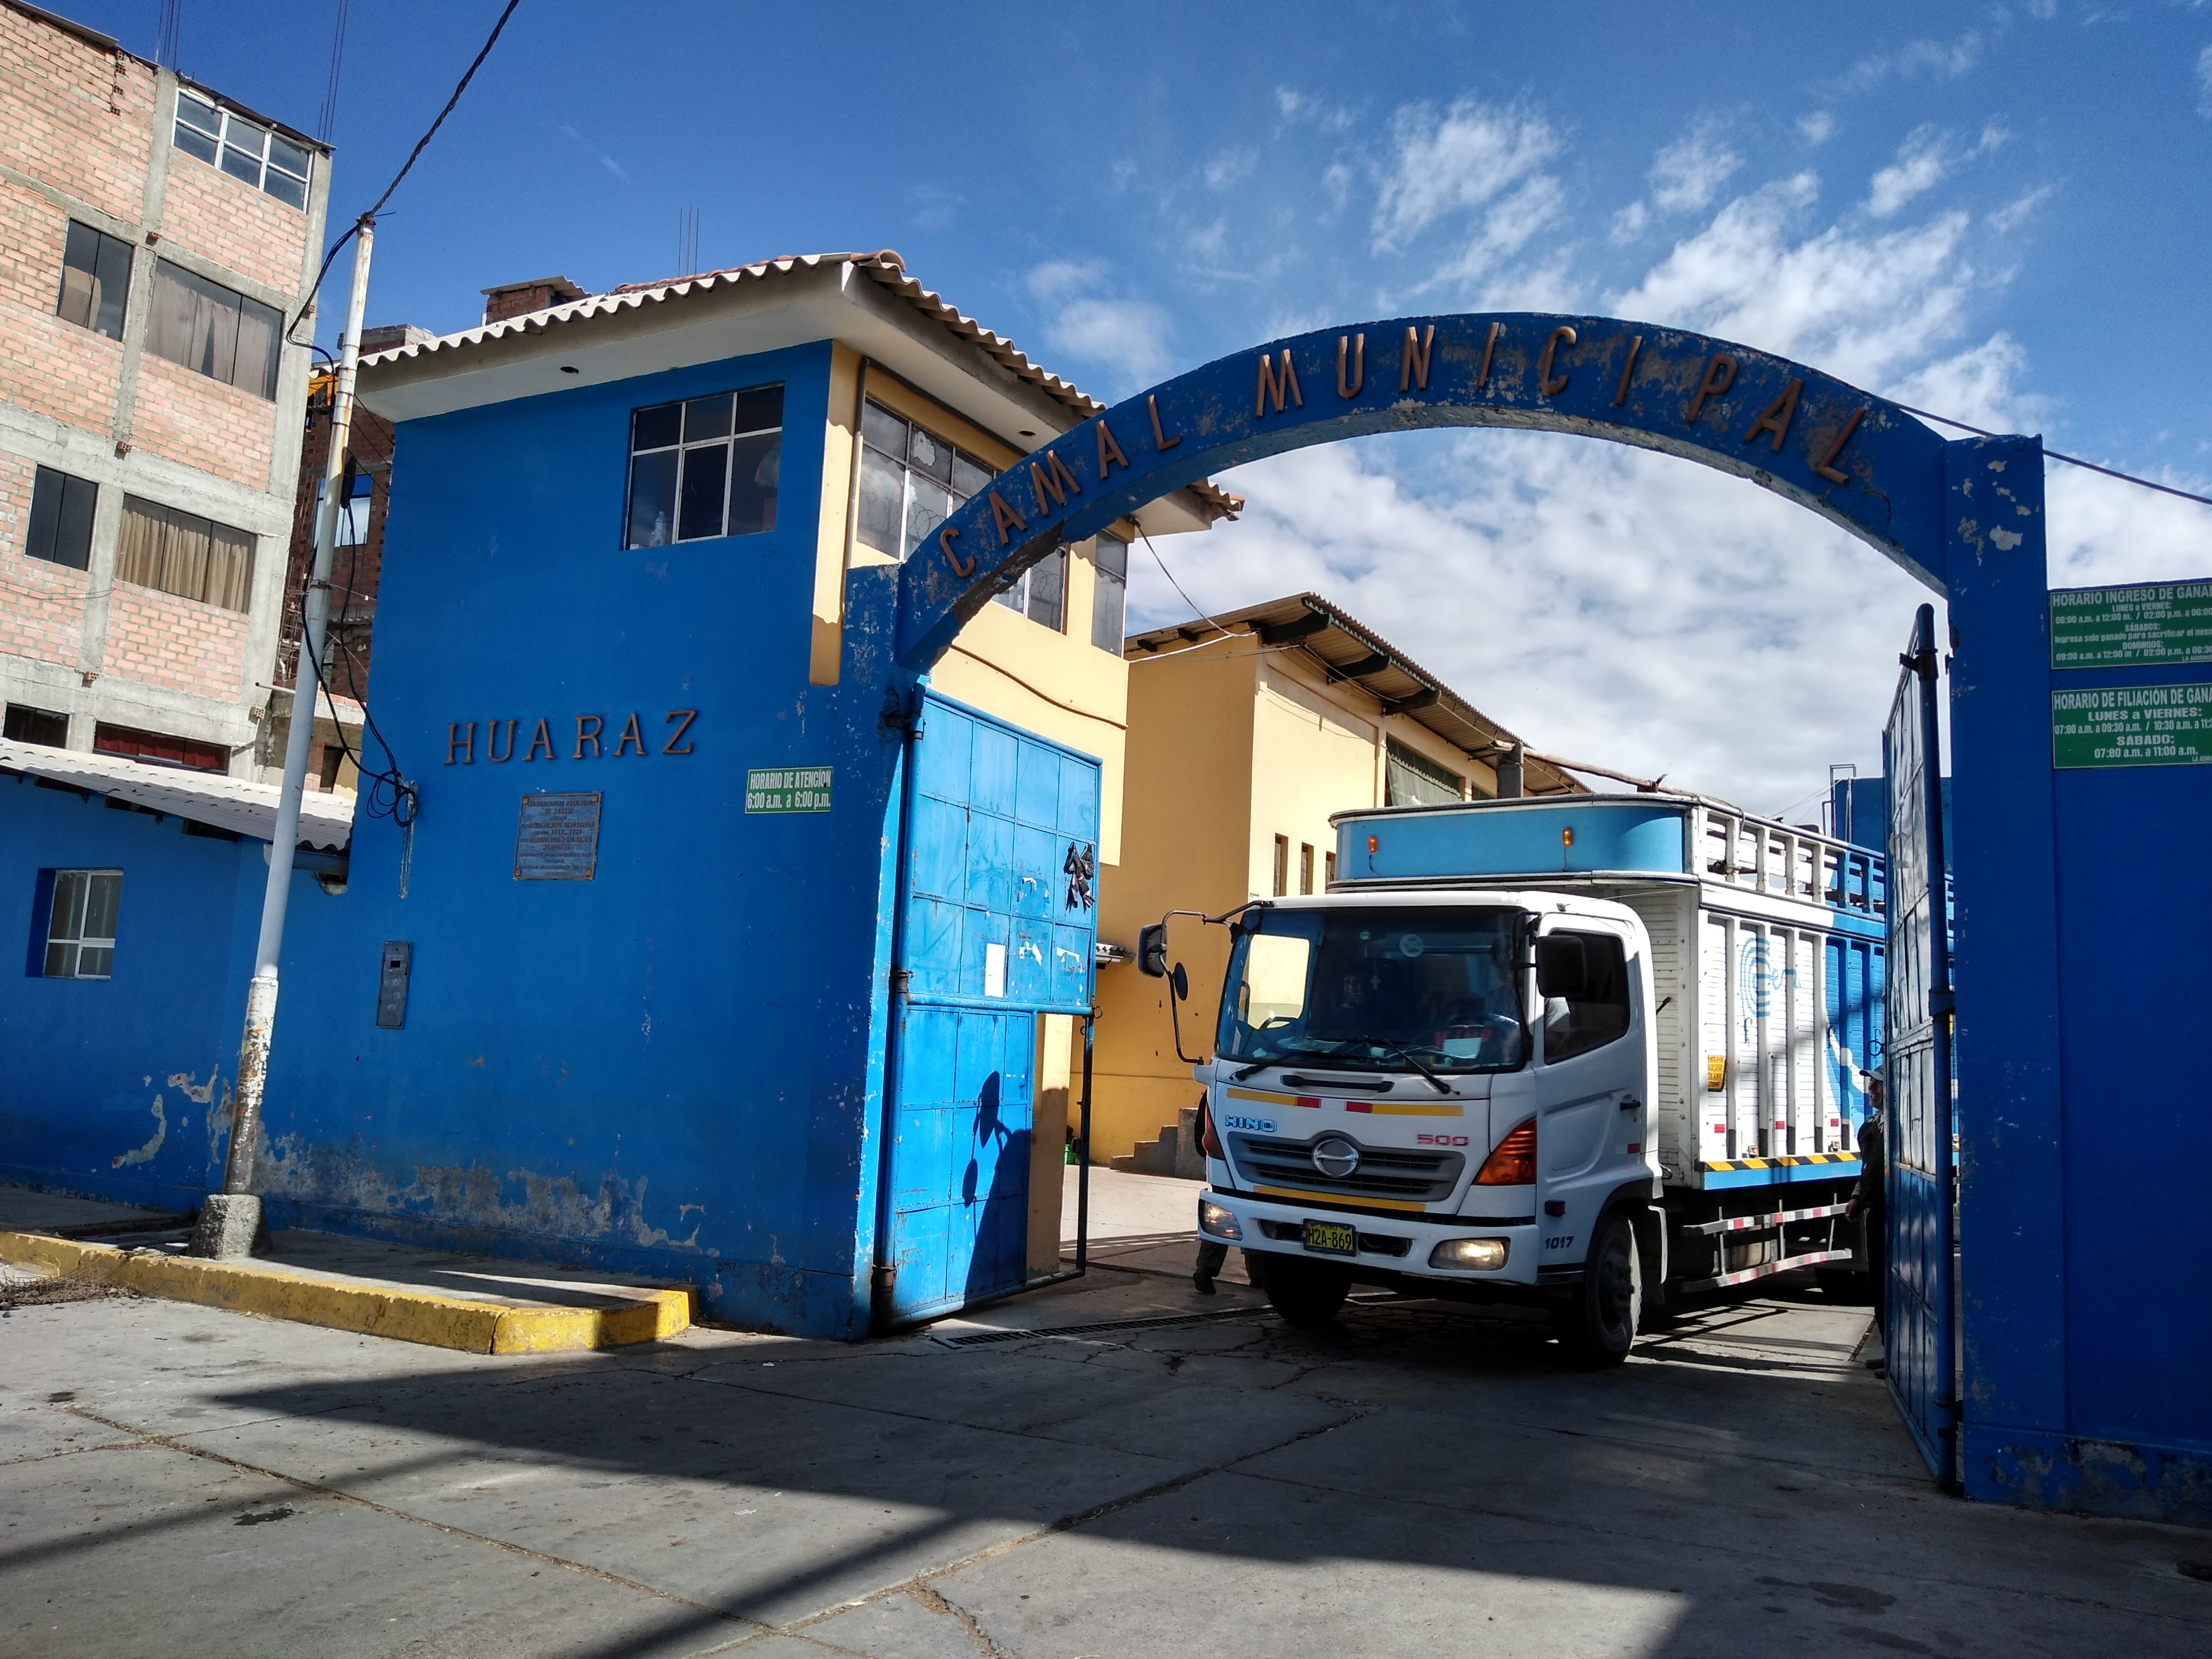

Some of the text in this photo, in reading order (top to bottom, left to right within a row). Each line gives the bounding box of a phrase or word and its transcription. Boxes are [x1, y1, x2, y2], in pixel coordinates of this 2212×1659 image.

[940, 322, 1866, 578] CAMAL MUNICIPAL
[2053, 592, 2102, 606] HORARIO
[2106, 588, 2155, 603] INGRESO
[2159, 587, 2173, 600] DE
[2112, 604, 2133, 612] LUNES
[2141, 602, 2172, 610] VIERNES:
[2055, 616, 2076, 624] 06:00
[2102, 613, 2121, 622] 12:00
[2144, 610, 2166, 619] 02:00
[2167, 610, 2183, 619] p.m.
[2055, 636, 2082, 644] Ingresa
[2101, 633, 2127, 642] ganado
[2128, 632, 2146, 640] para
[2147, 629, 2185, 638] sacrificar
[2122, 640, 2163, 650] DOMINGOS:
[2056, 652, 2077, 660] 09:00
[2103, 650, 2123, 658] 12:00
[2144, 648, 2166, 656] 02:00
[2168, 648, 2183, 656] p.m.
[2054, 692, 2099, 710] HORARIO
[2102, 692, 2115, 707] DE
[2117, 688, 2167, 707] FILIACIÓN
[2170, 689, 2183, 704] DE
[2088, 707, 2202, 721] LUNES a VIERNES:
[2078, 725, 2094, 733] a.m.
[2095, 725, 2100, 733] a
[2102, 723, 2123, 732] 09:30
[2126, 723, 2141, 732] a.m.
[2154, 720, 2174, 731] 10:30
[2176, 721, 2193, 730] a.m.
[2194, 720, 2199, 729] a
[443, 709, 698, 765] HUARAZ
[2117, 734, 2174, 746] SÁBADO:
[2123, 748, 2143, 757] a.m.
[2145, 748, 2150, 756] a
[2153, 746, 2176, 756] 11:00
[2178, 746, 2198, 756] a.m.
[750, 772, 783, 790] HORARIO
[784, 772, 794, 788] DE
[747, 791, 831, 810] 6:00 a.m. a 6:00 p.m.
[1225, 1115, 1277, 1132] HINO
[1418, 1134, 1469, 1147] 500
[1307, 1227, 1352, 1250] H2A-869
[1546, 1236, 1574, 1249] 1017
